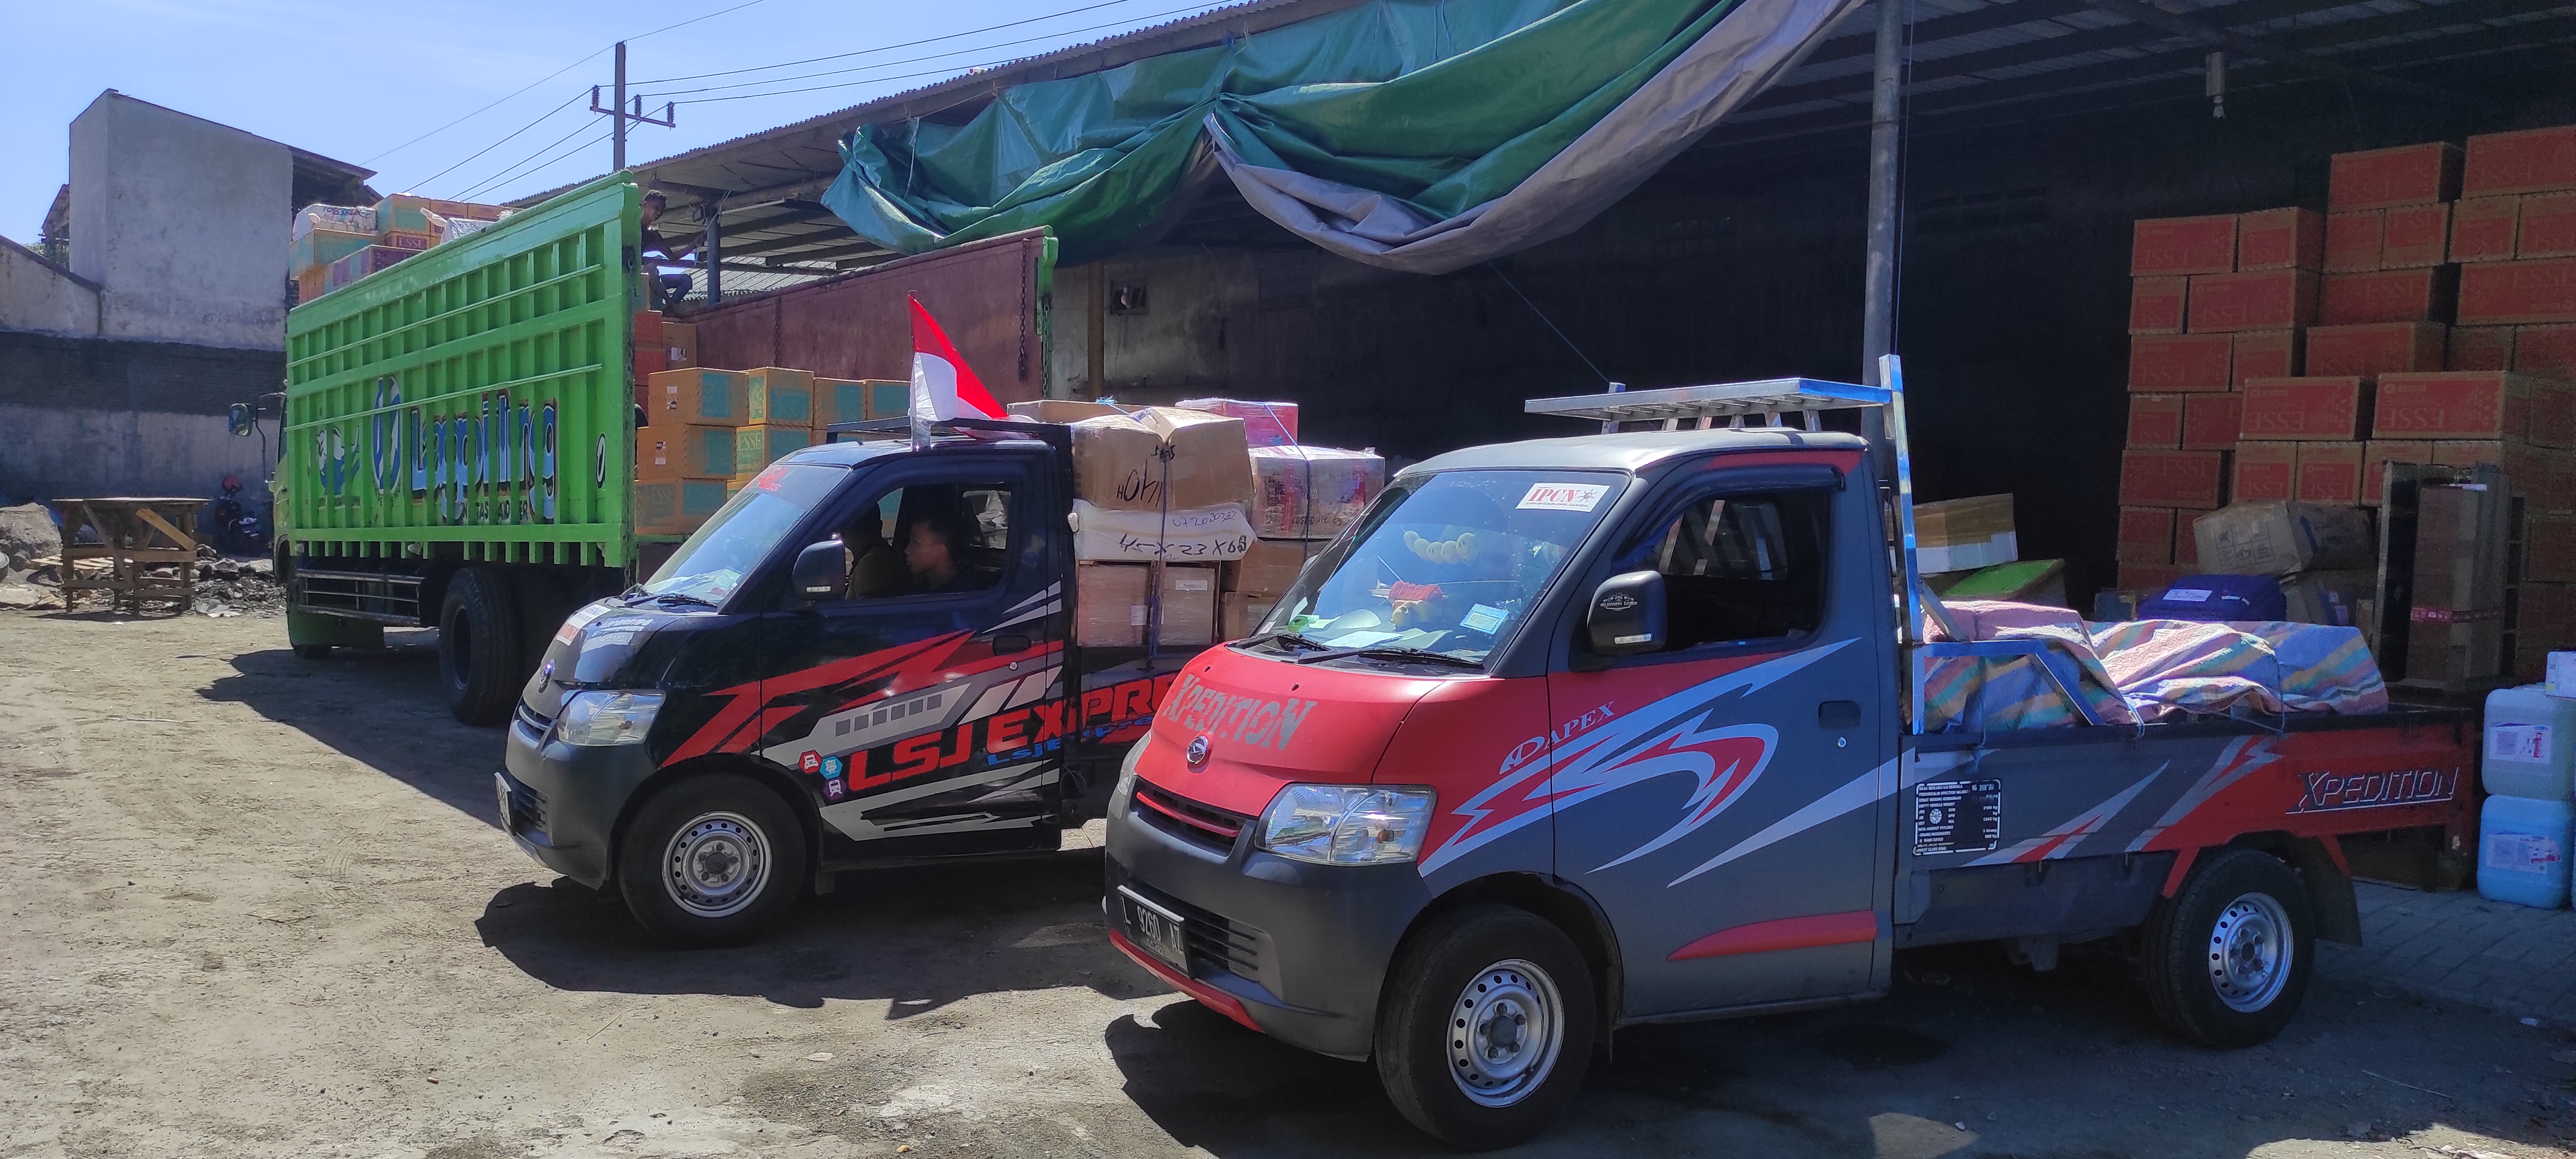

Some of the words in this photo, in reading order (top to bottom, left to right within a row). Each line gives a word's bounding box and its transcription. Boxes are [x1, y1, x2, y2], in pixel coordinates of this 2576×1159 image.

[400, 239, 424, 248] ESSE
[2249, 411, 2305, 431] ESSE
[2381, 408, 2445, 429] ESSE
[739, 434, 761, 451] ESSE
[1528, 489, 1581, 502] IPCN
[1163, 674, 1317, 751] XPEDITION
[1543, 701, 1615, 750] APEX
[849, 722, 972, 792] LSJ
[2297, 766, 2460, 813] XPEDITION
[1121, 896, 1131, 925] L
[1136, 904, 1161, 942] 9260
[1169, 922, 1184, 955] AZ
